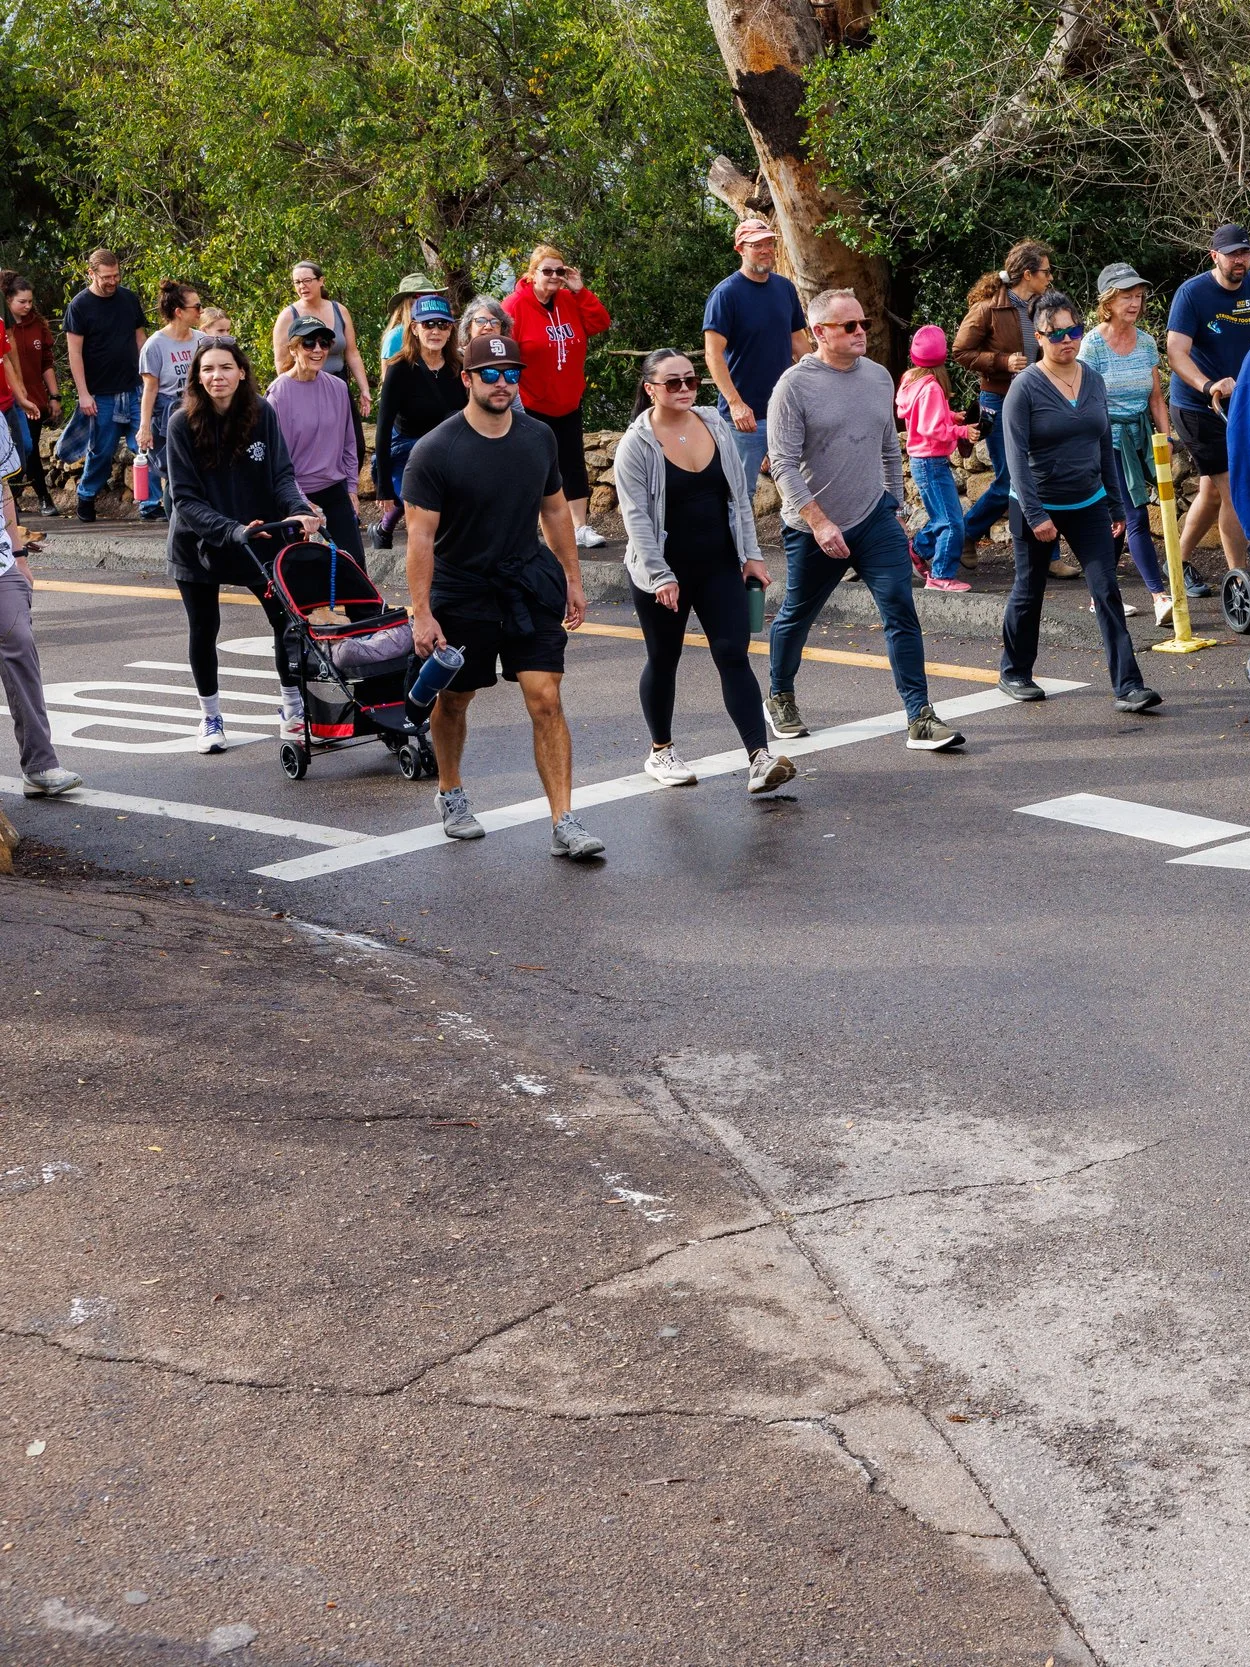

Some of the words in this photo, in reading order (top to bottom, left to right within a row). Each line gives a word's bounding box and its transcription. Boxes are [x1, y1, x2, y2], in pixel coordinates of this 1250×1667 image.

[490, 339, 507, 356] SD
[170, 352, 177, 363] A
[177, 350, 192, 361] LOT
